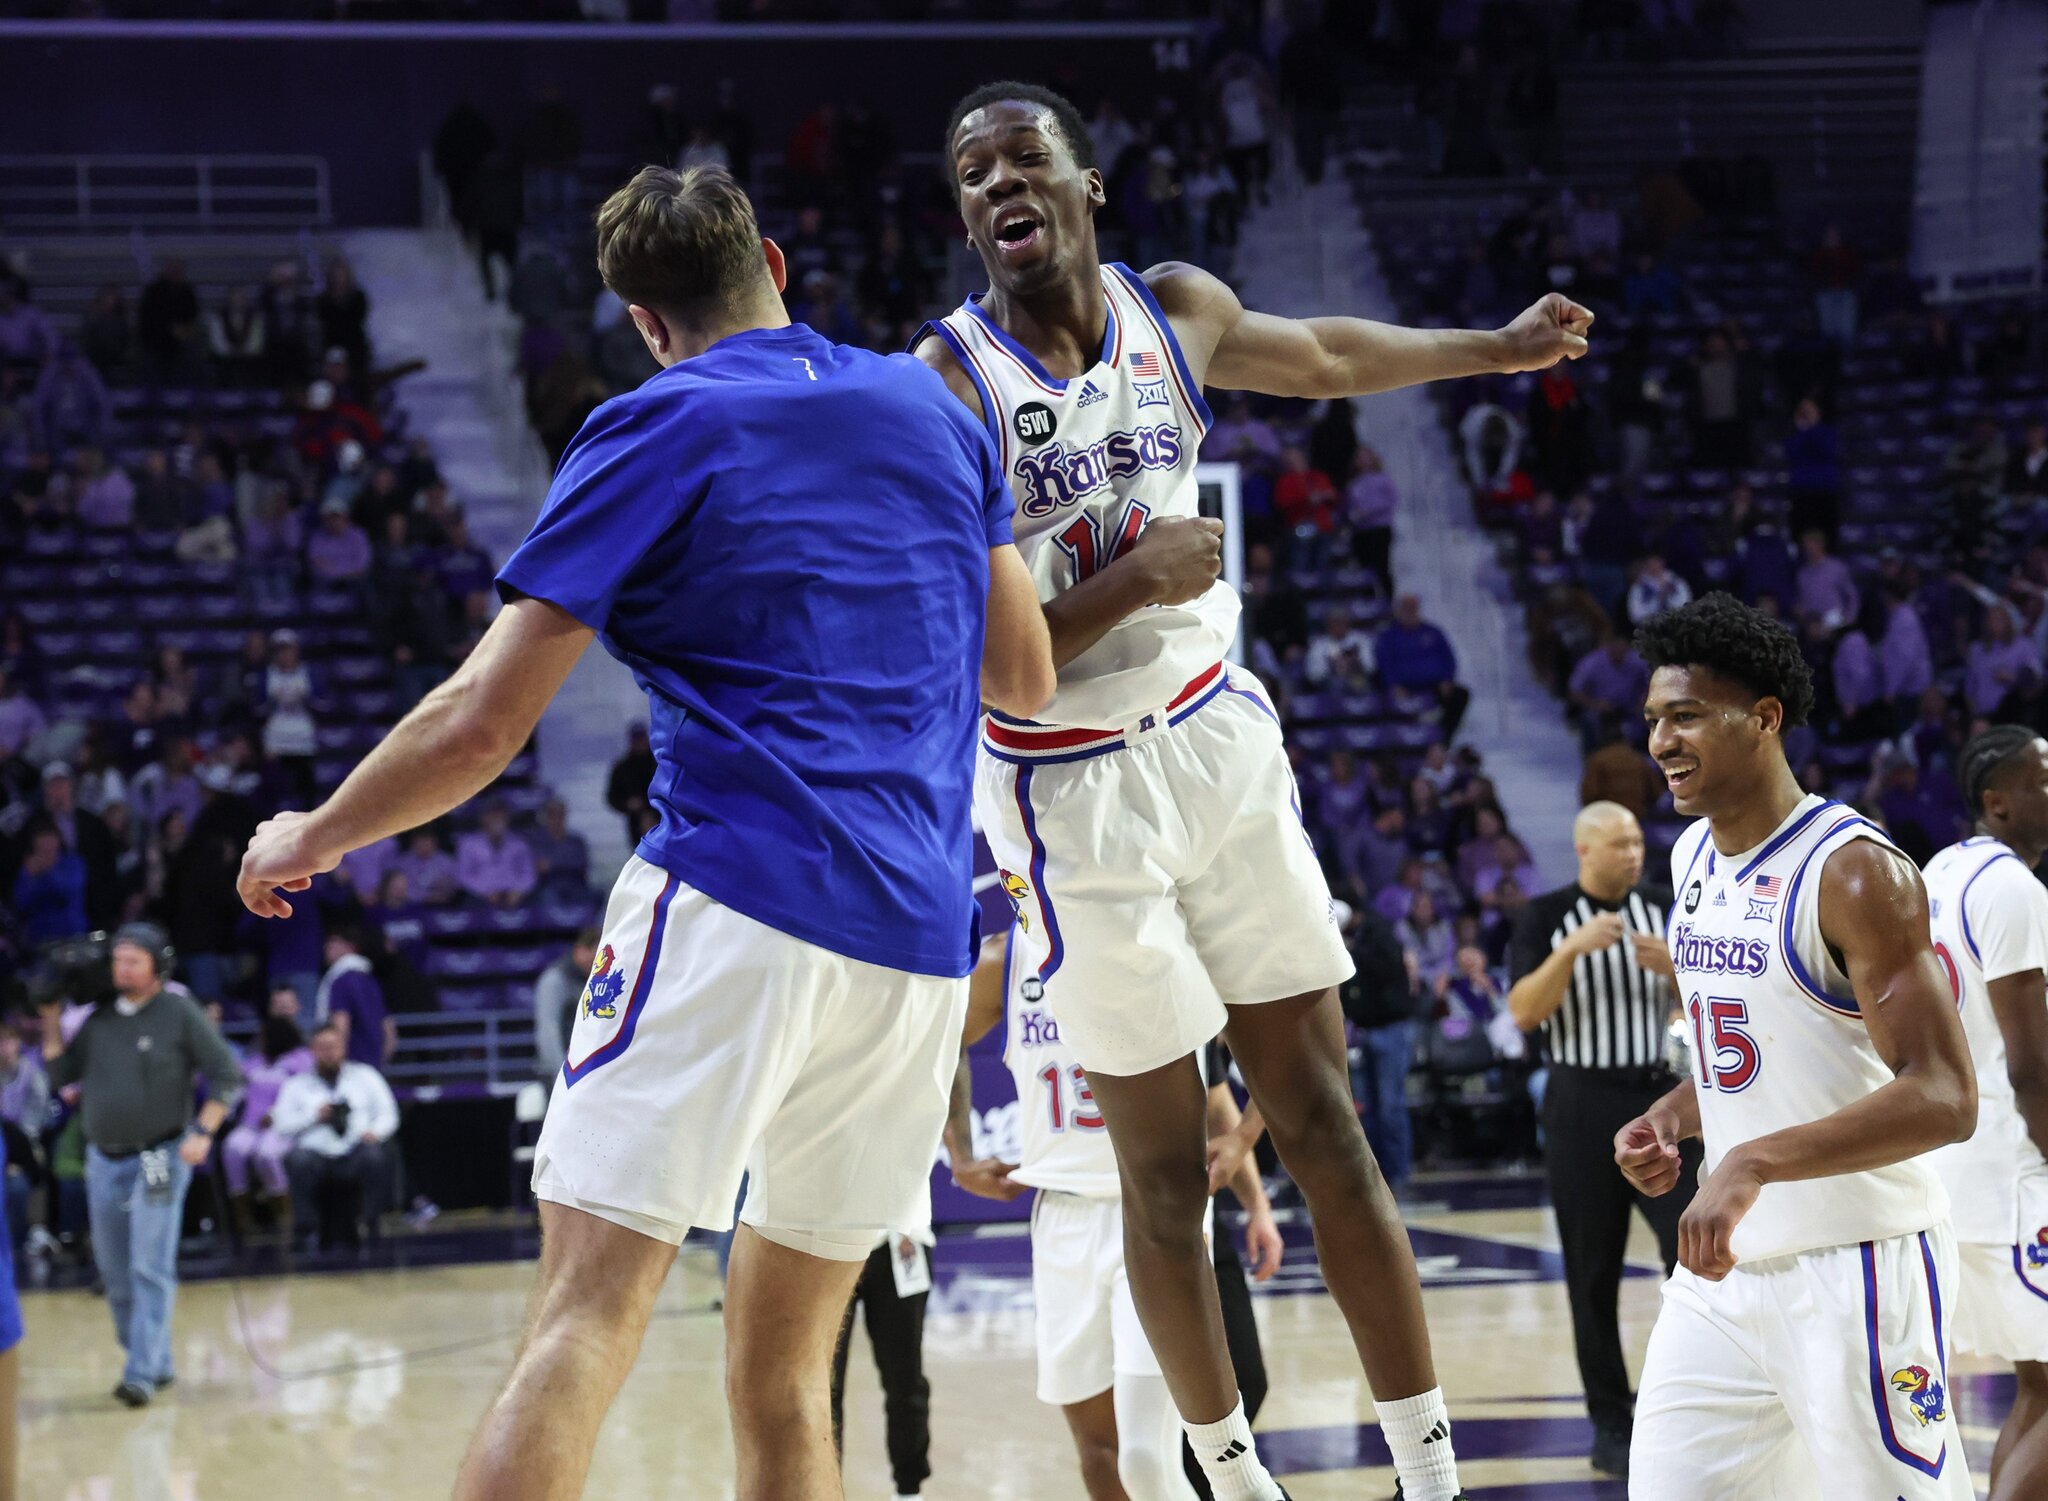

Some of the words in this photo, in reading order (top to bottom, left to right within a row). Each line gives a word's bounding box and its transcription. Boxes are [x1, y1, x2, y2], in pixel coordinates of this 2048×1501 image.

[1077, 390, 1109, 409] adidas
[1017, 409, 1049, 437] SW
[1014, 423, 1182, 518] Kansas
[1674, 921, 1770, 978] Kansas
[593, 982, 608, 997] KU
[1688, 991, 1761, 1094] 15
[1921, 1393, 1937, 1408] KU
